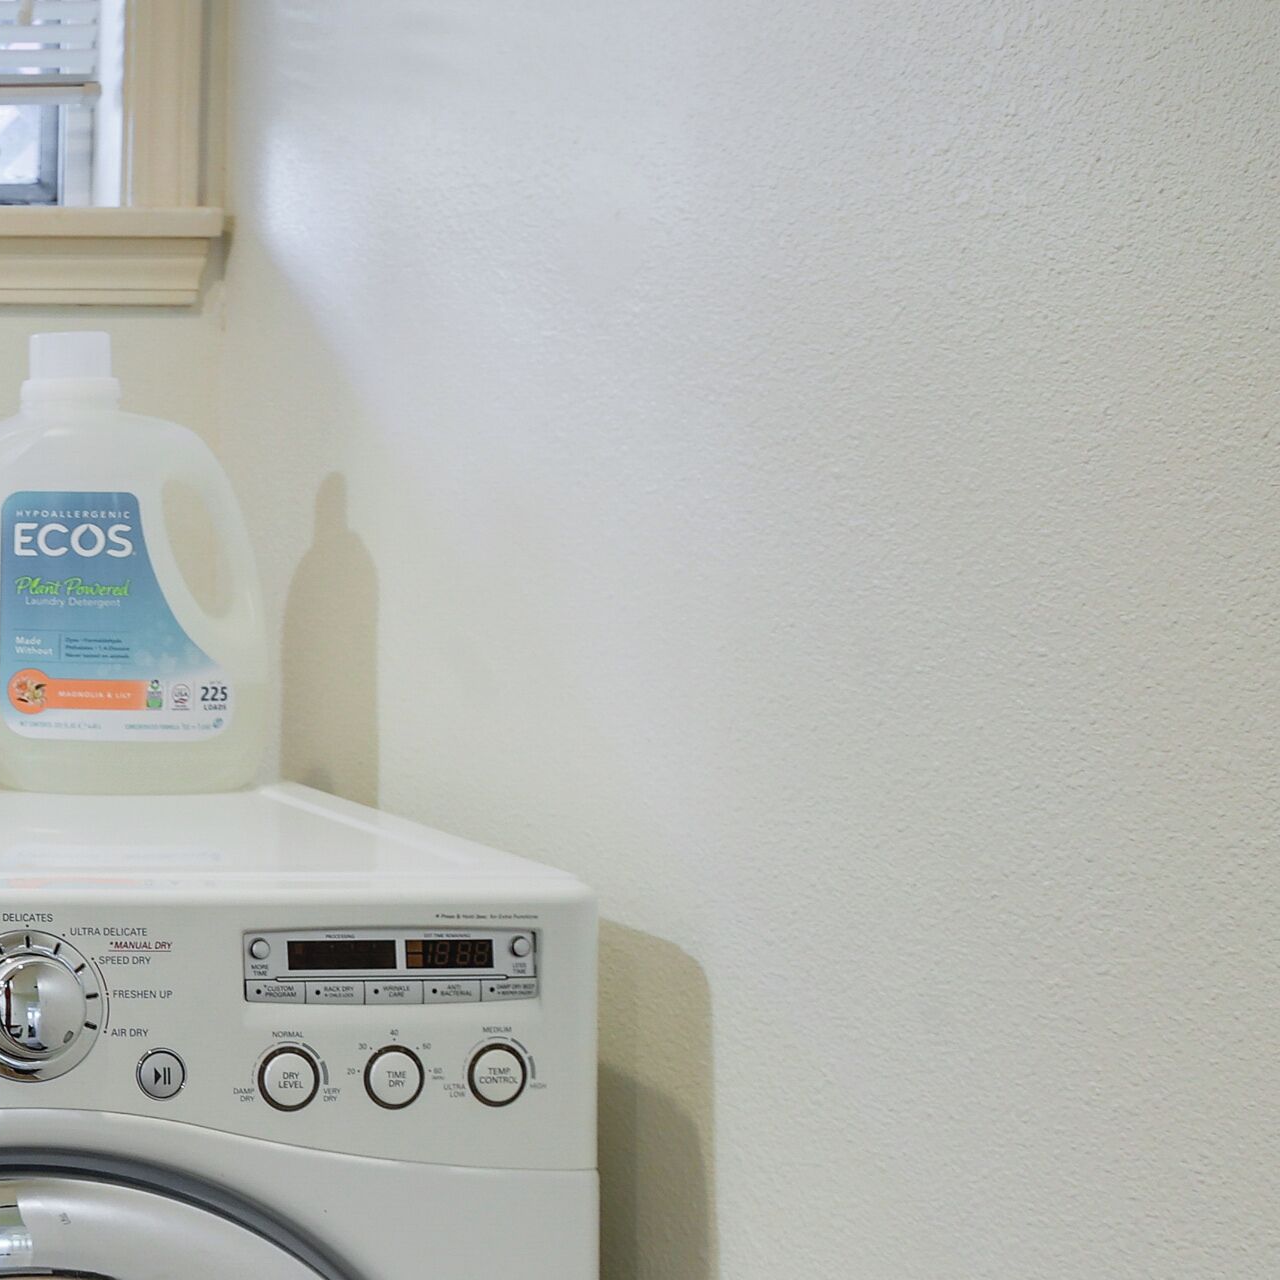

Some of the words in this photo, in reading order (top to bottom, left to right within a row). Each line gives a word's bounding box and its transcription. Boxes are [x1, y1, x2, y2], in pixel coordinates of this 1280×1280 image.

[15, 510, 131, 519] HYPOALLERGENIC
[14, 522, 133, 558] ECOS
[15, 576, 62, 595] Plant
[64, 577, 131, 596] Powered
[25, 596, 64, 607] Laundry
[68, 597, 120, 608] Detergent
[15, 636, 41, 645] Made
[15, 646, 53, 655] Without
[58, 690, 104, 698] MAGNOLIA
[201, 686, 228, 701] 225
[2, 913, 53, 923] DELICATES
[70, 927, 100, 936] ULTRA
[103, 928, 148, 936] DELICATE
[154, 942, 172, 950] DRY
[99, 956, 128, 965] SPEED
[130, 956, 151, 965] DRY
[113, 990, 156, 999] FRESHEN
[159, 990, 173, 999] UP
[111, 1028, 127, 1037] AIR
[129, 1028, 149, 1037] DRY
[282, 1072, 299, 1080] DRY
[479, 1076, 518, 1084] CONTROL
[278, 1081, 304, 1089] LEVEL
[388, 1080, 406, 1088] DRY
